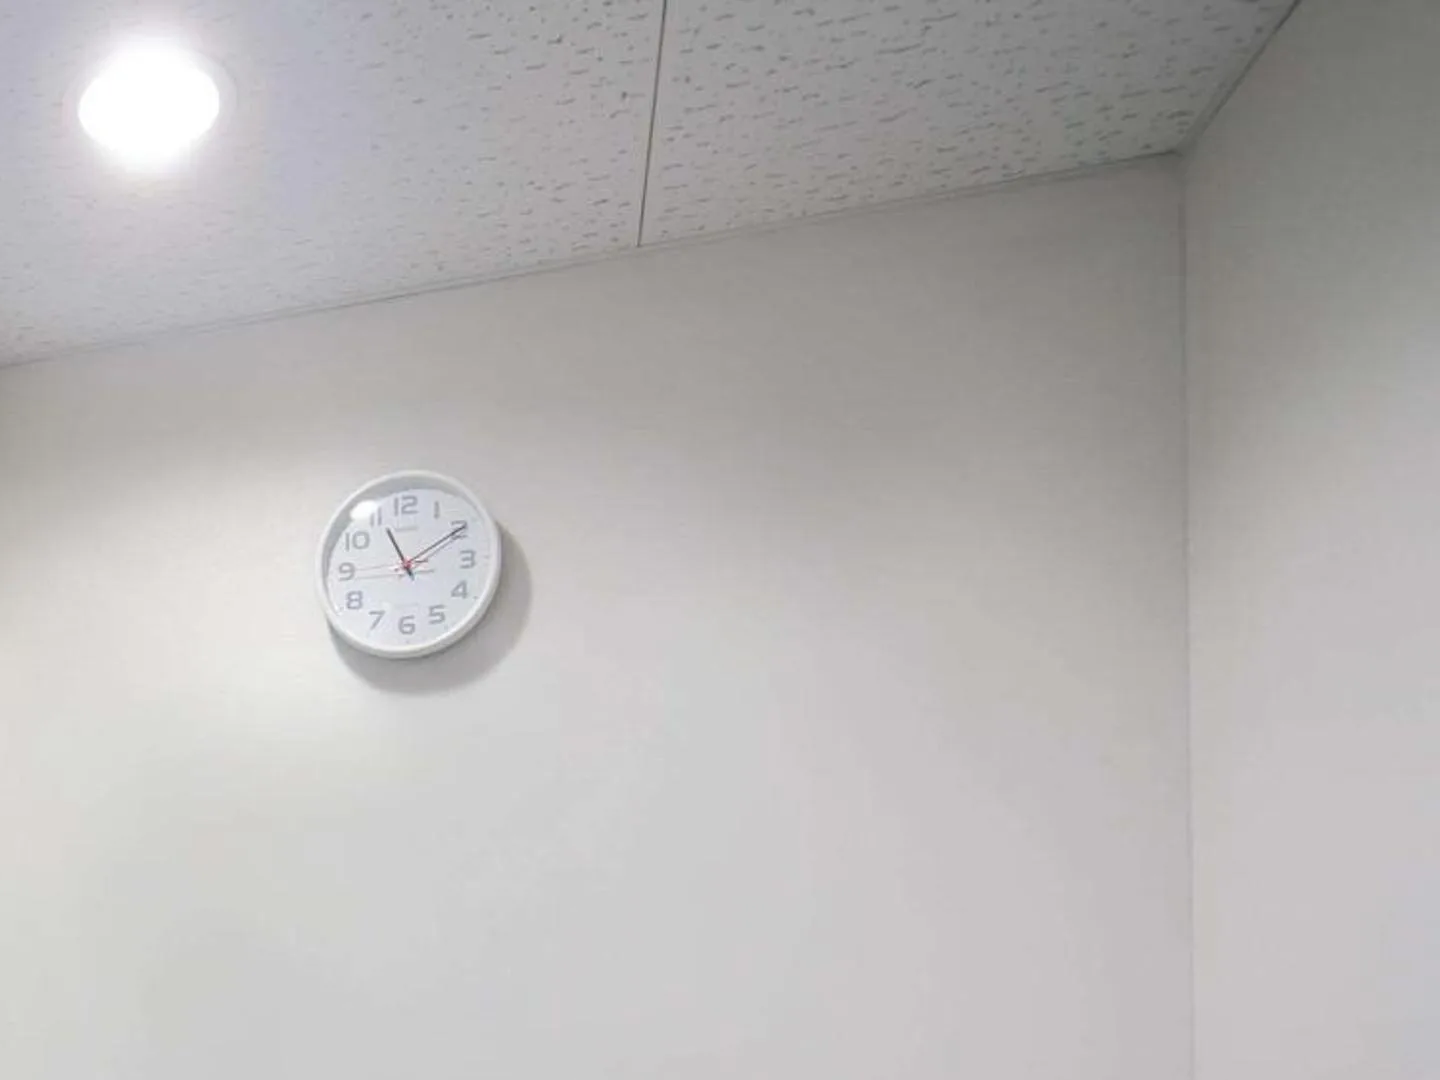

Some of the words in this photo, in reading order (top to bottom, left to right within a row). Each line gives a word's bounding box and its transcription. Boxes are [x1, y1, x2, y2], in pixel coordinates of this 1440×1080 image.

[394, 495, 418, 516] 12
[434, 501, 440, 519] 1
[370, 507, 382, 527] 11
[451, 520, 467, 540] 2
[345, 532, 369, 551] 10
[460, 550, 476, 569] 3
[338, 563, 354, 581] 9
[451, 581, 467, 598] 4
[346, 591, 363, 610] 8
[369, 611, 385, 630] 7
[429, 605, 445, 624] 5
[398, 616, 415, 634] 6
